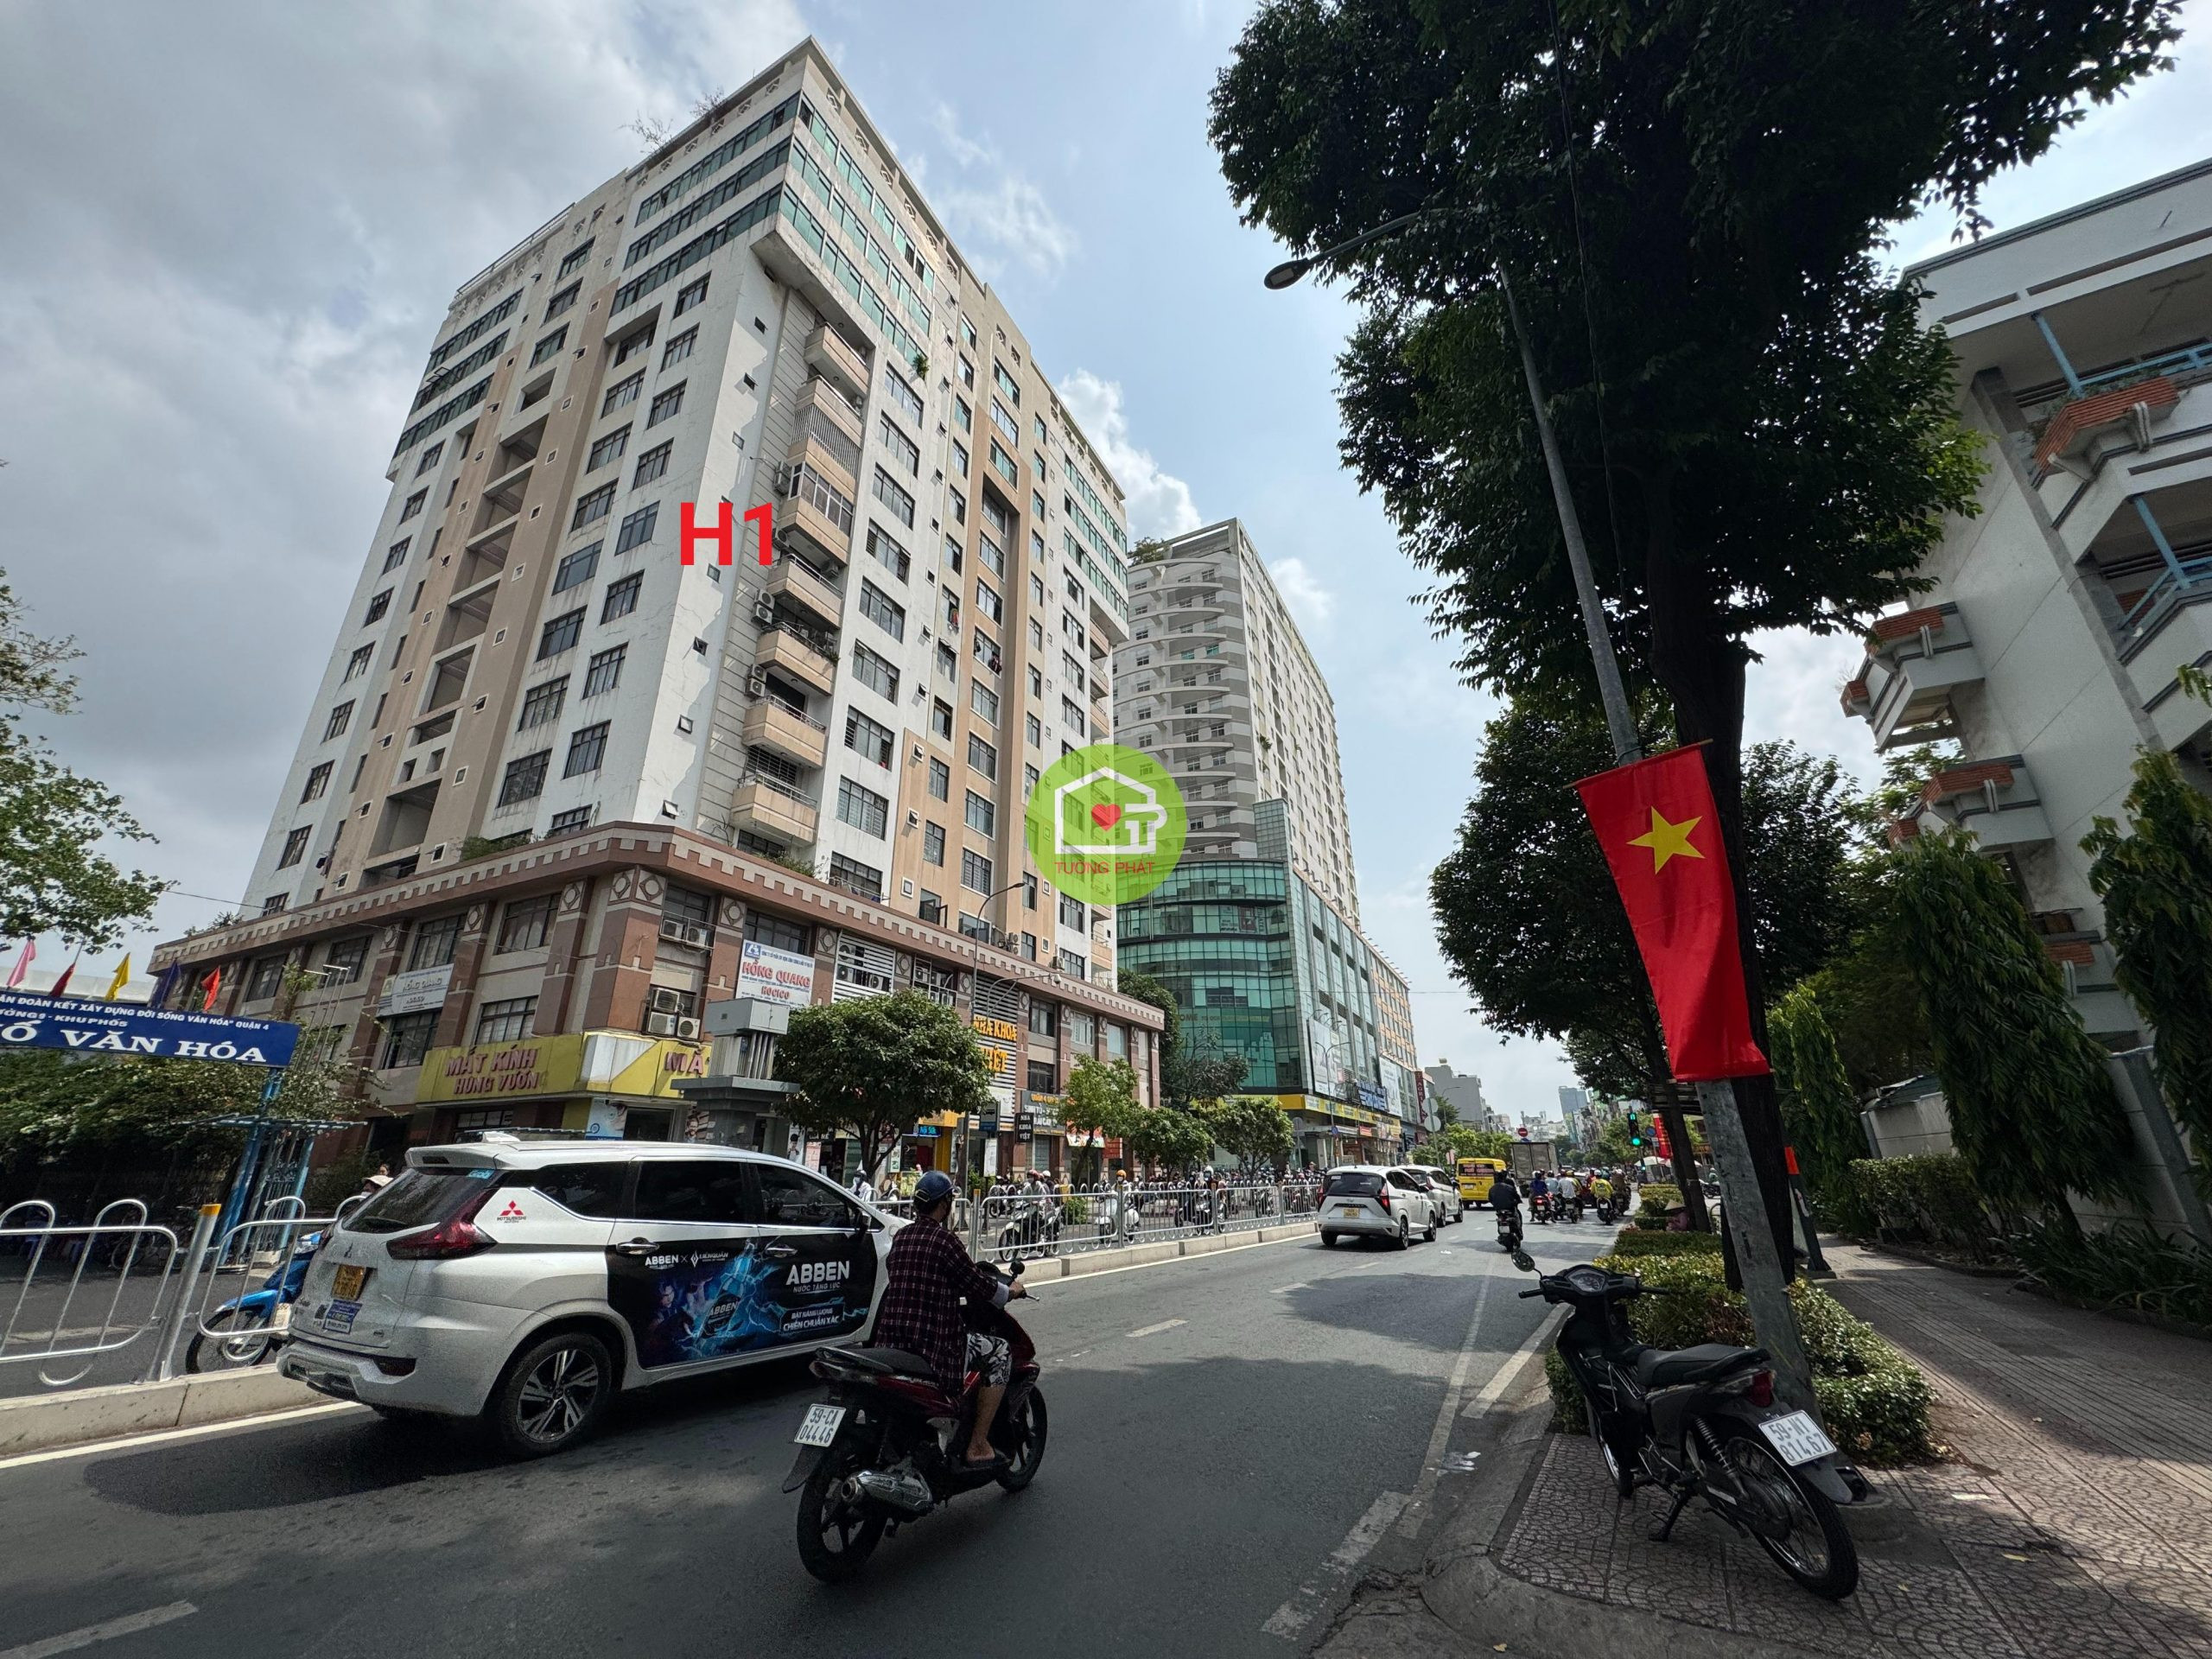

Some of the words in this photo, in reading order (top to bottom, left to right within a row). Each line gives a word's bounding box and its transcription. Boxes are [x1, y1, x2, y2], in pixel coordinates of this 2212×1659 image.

[741, 959, 773, 979] HỒNG
[776, 970, 810, 988] QUANG
[761, 985, 790, 1000] HOCICO
[0, 995, 16, 1003] ÂN
[17, 996, 51, 1007] ĐOÀN
[54, 1001, 78, 1010] KẾT
[79, 1003, 103, 1013] XÂY
[105, 1006, 136, 1016] DỰNG
[156, 1011, 185, 1021] SỐNG
[235, 1020, 261, 1030] QUẬN
[54, 1014, 87, 1024] KHU
[994, 1020, 1017, 1041] KHOA
[60, 1029, 163, 1053] VĂN
[175, 1040, 266, 1062] HÓA
[445, 1046, 488, 1077] MẮT
[492, 1044, 538, 1071] KÍNH
[664, 1047, 710, 1074] MẮ
[1020, 1132, 1030, 1141] VIỆT
[645, 1255, 679, 1266] ABBEN
[785, 1261, 850, 1286] ABBEN
[792, 1284, 810, 1293] NƯỚC
[812, 1282, 829, 1291] TĂNG
[709, 1301, 739, 1315] ABBEN
[810, 1408, 839, 1426] 59-CA
[1779, 1433, 1828, 1462] 814.67
